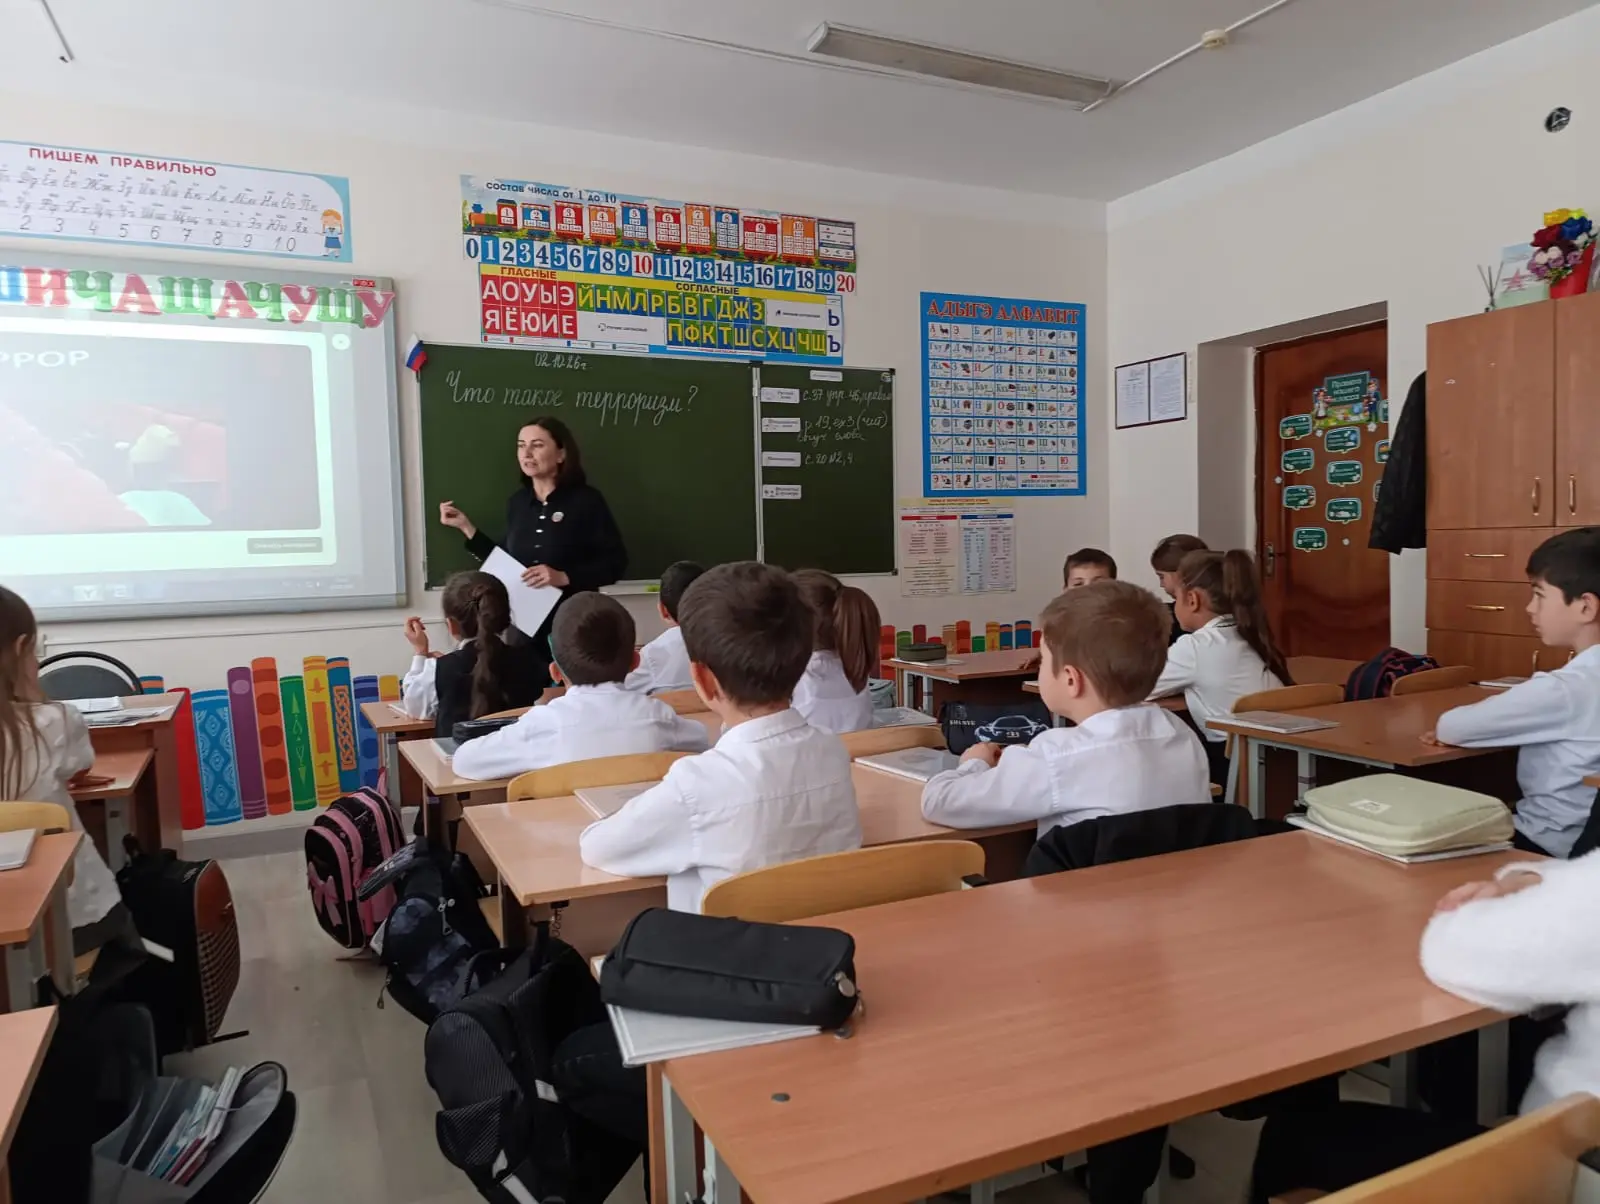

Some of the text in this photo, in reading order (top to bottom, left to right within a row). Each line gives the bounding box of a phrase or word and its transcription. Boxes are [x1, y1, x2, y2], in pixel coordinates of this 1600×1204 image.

[29, 147, 217, 177] ПИШЕМ ПРАВИЛЬНО
[604, 193, 617, 204] 10
[20, 215, 31, 230] 2
[55, 217, 65, 232] 3
[119, 223, 129, 237] 5
[150, 225, 161, 240] 6
[182, 228, 192, 242] 7
[212, 230, 223, 246] 8
[243, 233, 253, 247] 9
[273, 236, 297, 251] 10
[466, 238, 855, 293] 0 1 2 3 4 5 6 7 8 9 10 11 12 13 14 15 16 17 18 19 20
[500, 266, 557, 280] ГЛАСНЫЕ
[675, 282, 740, 295] СОГЛАСНЫЕ
[927, 299, 1080, 325] АДЫГЭ АЛФАВИТ
[446, 369, 495, 404] Что
[503, 386, 563, 407] такое
